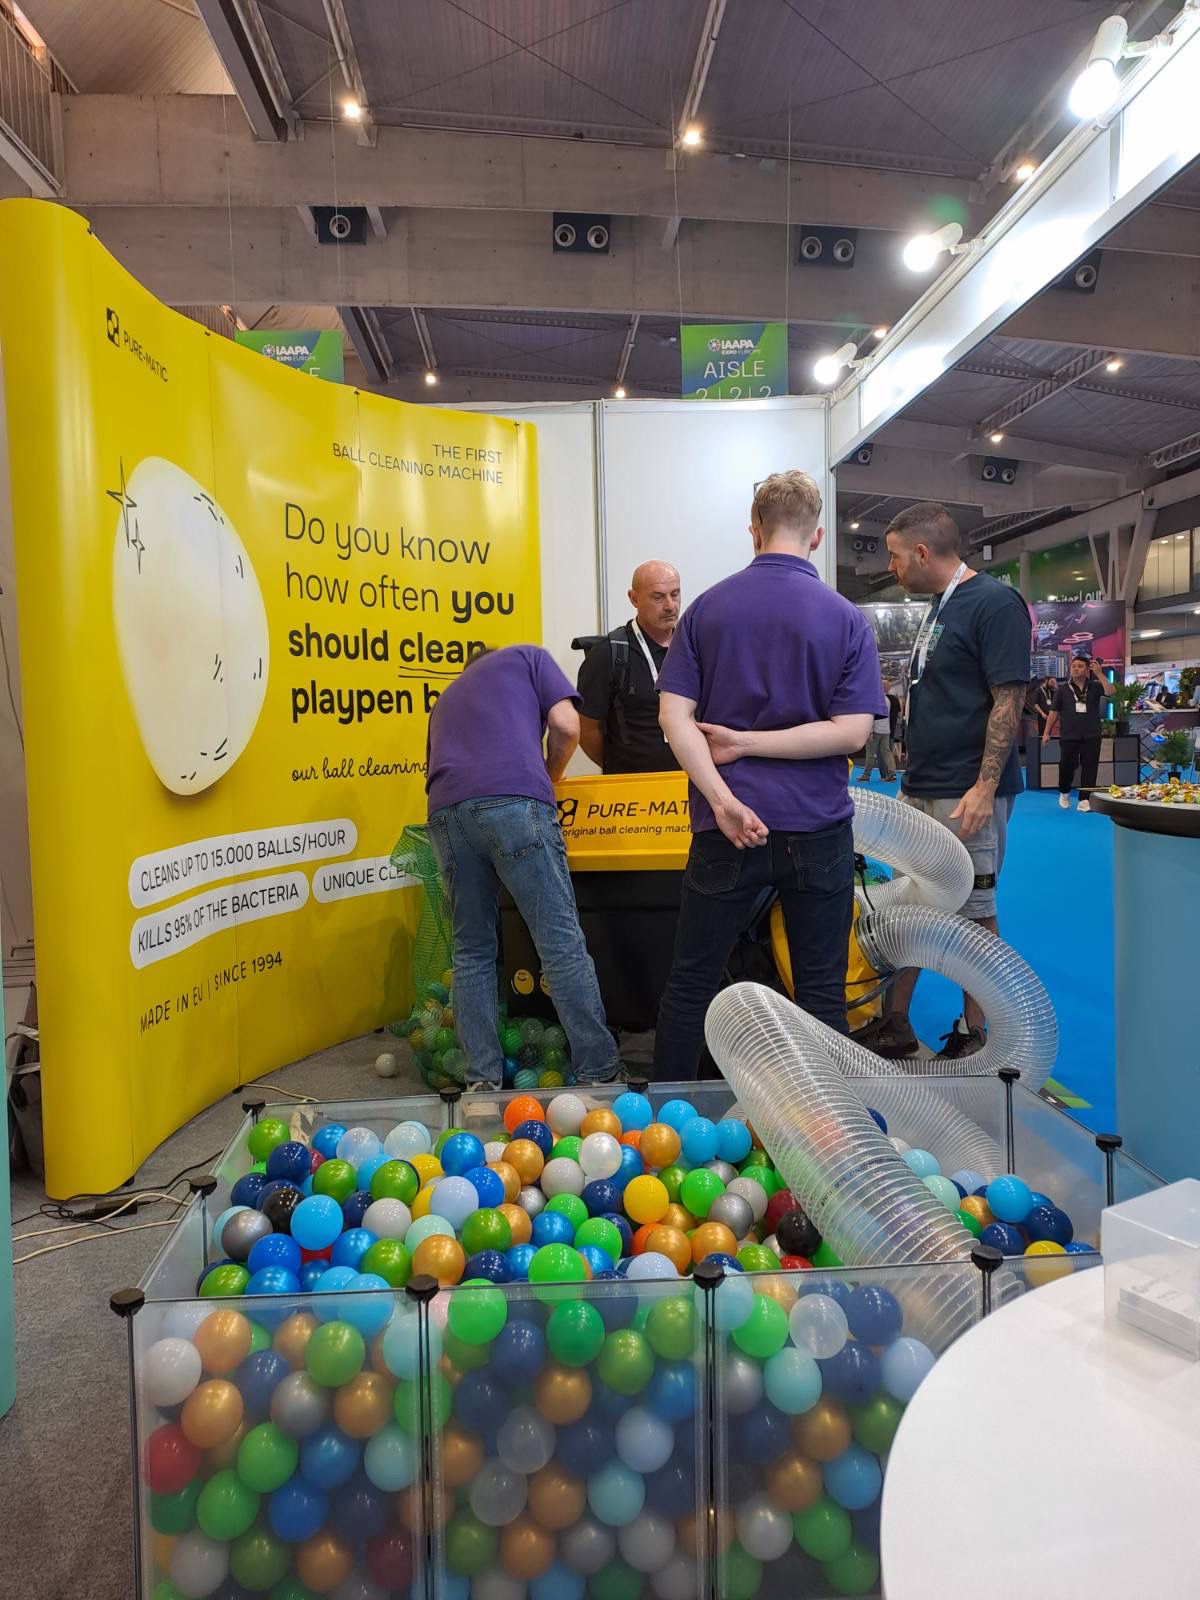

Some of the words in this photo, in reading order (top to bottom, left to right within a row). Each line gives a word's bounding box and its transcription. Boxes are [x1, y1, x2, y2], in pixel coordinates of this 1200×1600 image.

[123, 329, 168, 383] PURE-MATIC
[275, 345, 309, 355] IAAPA
[721, 339, 754, 349] IAAPA
[703, 360, 766, 378] AISLE
[332, 442, 366, 463] BALL
[368, 451, 434, 477] CLEANING
[438, 464, 503, 484] MACHINE
[432, 443, 461, 460] THE
[465, 447, 503, 465] FIRST
[285, 502, 325, 545] Do
[335, 522, 390, 561] you
[400, 526, 490, 565] know
[285, 561, 349, 604] how
[359, 574, 439, 613] often
[451, 590, 514, 624] you
[288, 622, 389, 661] should
[291, 679, 413, 724] playpen
[291, 765, 319, 782] our
[322, 756, 355, 779] ball
[562, 826, 597, 838] original
[599, 825, 617, 835] ball
[619, 825, 662, 836] cleaning
[140, 861, 180, 892] CLEANS
[181, 856, 193, 878] UP
[194, 851, 209, 875] TO
[210, 843, 254, 868] 15.000
[257, 829, 346, 858] BALLS/HOUR
[322, 867, 375, 892] UNIQUE
[138, 922, 172, 954] KILLS
[173, 914, 193, 939] 95%
[193, 906, 205, 929] OF
[205, 898, 228, 922] THE
[231, 882, 300, 914] BACTERIA
[139, 1000, 171, 1035] MADE
[176, 993, 189, 1013] IN
[192, 984, 203, 1007] EU
[214, 961, 247, 991] SINCE
[251, 951, 283, 974] 1994
